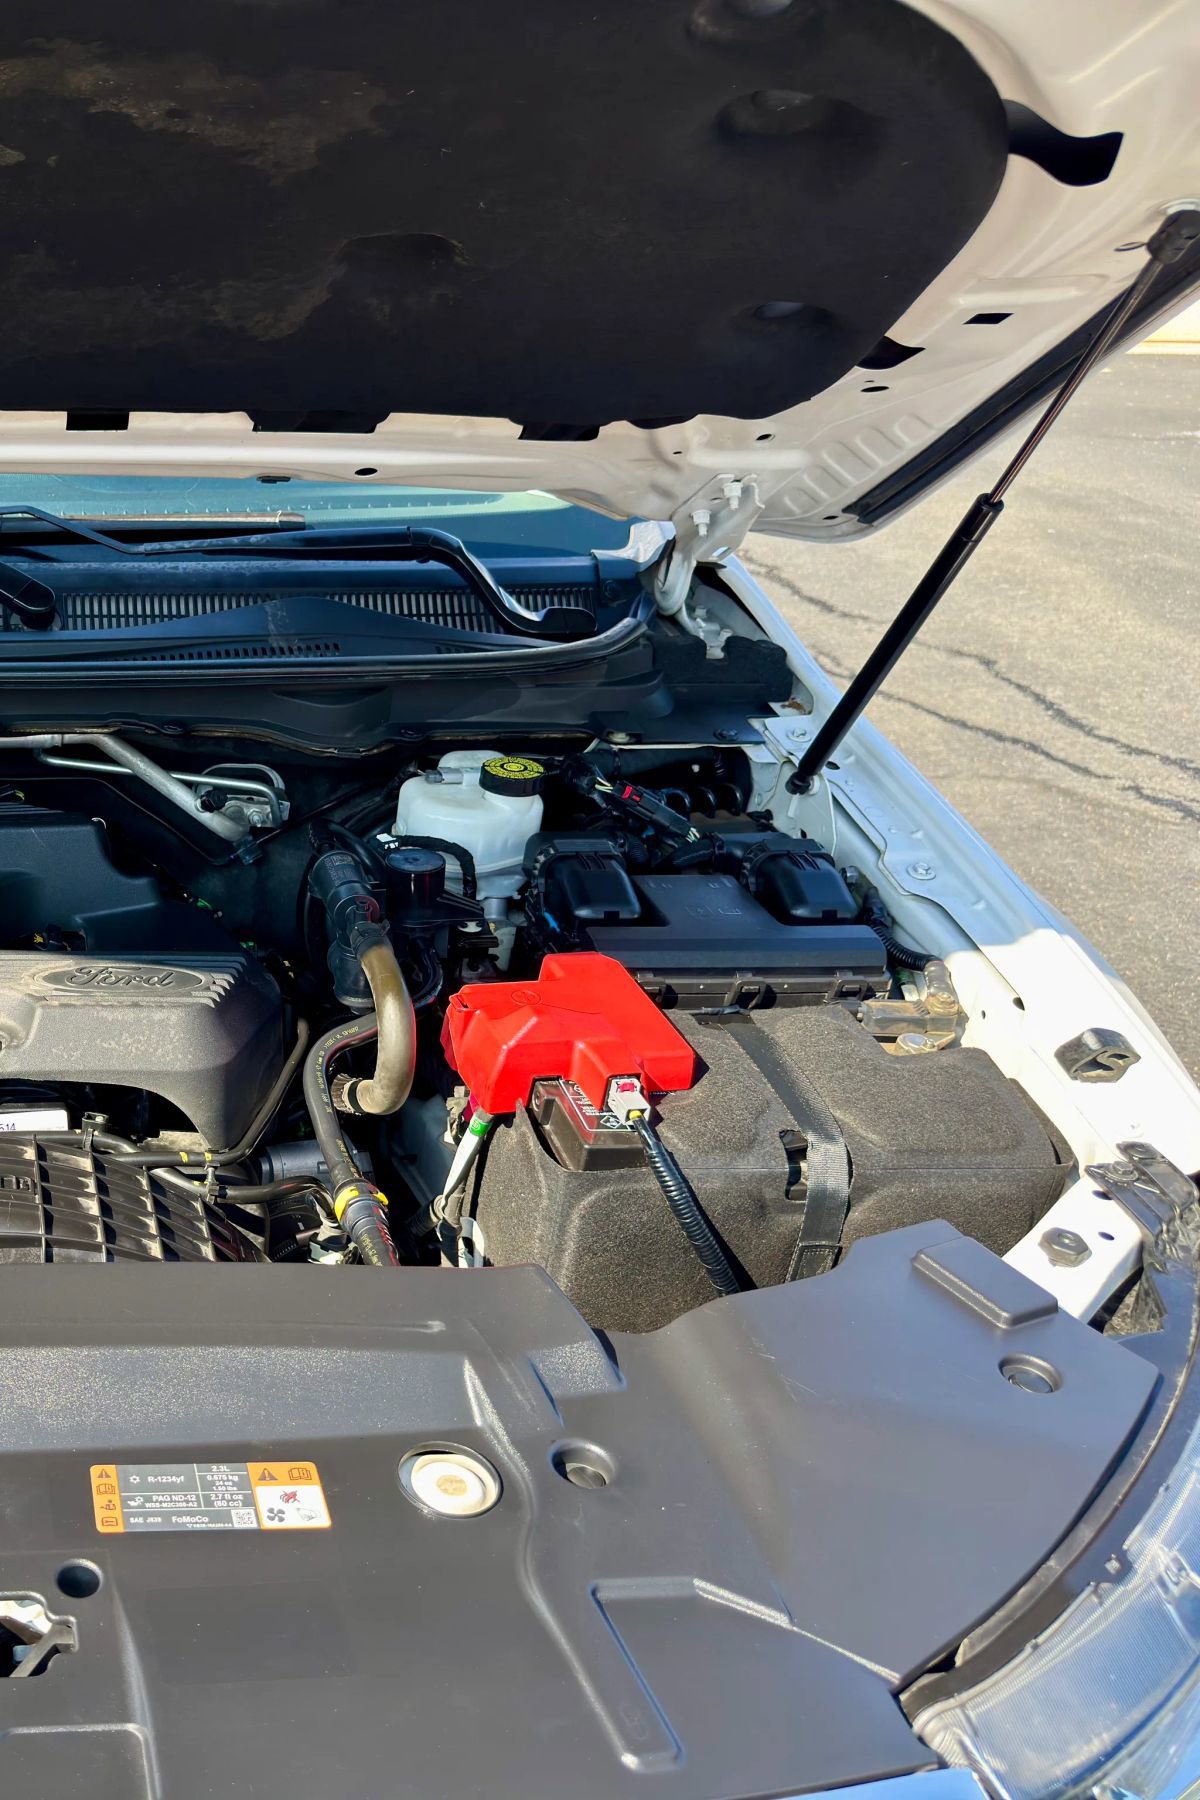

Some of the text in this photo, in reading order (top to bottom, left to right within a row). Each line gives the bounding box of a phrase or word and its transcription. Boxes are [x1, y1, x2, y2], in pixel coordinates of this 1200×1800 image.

[64, 965, 176, 988] Ford
[147, 1475, 185, 1484] R-1234yf
[171, 1515, 209, 1523] FoMoCo
